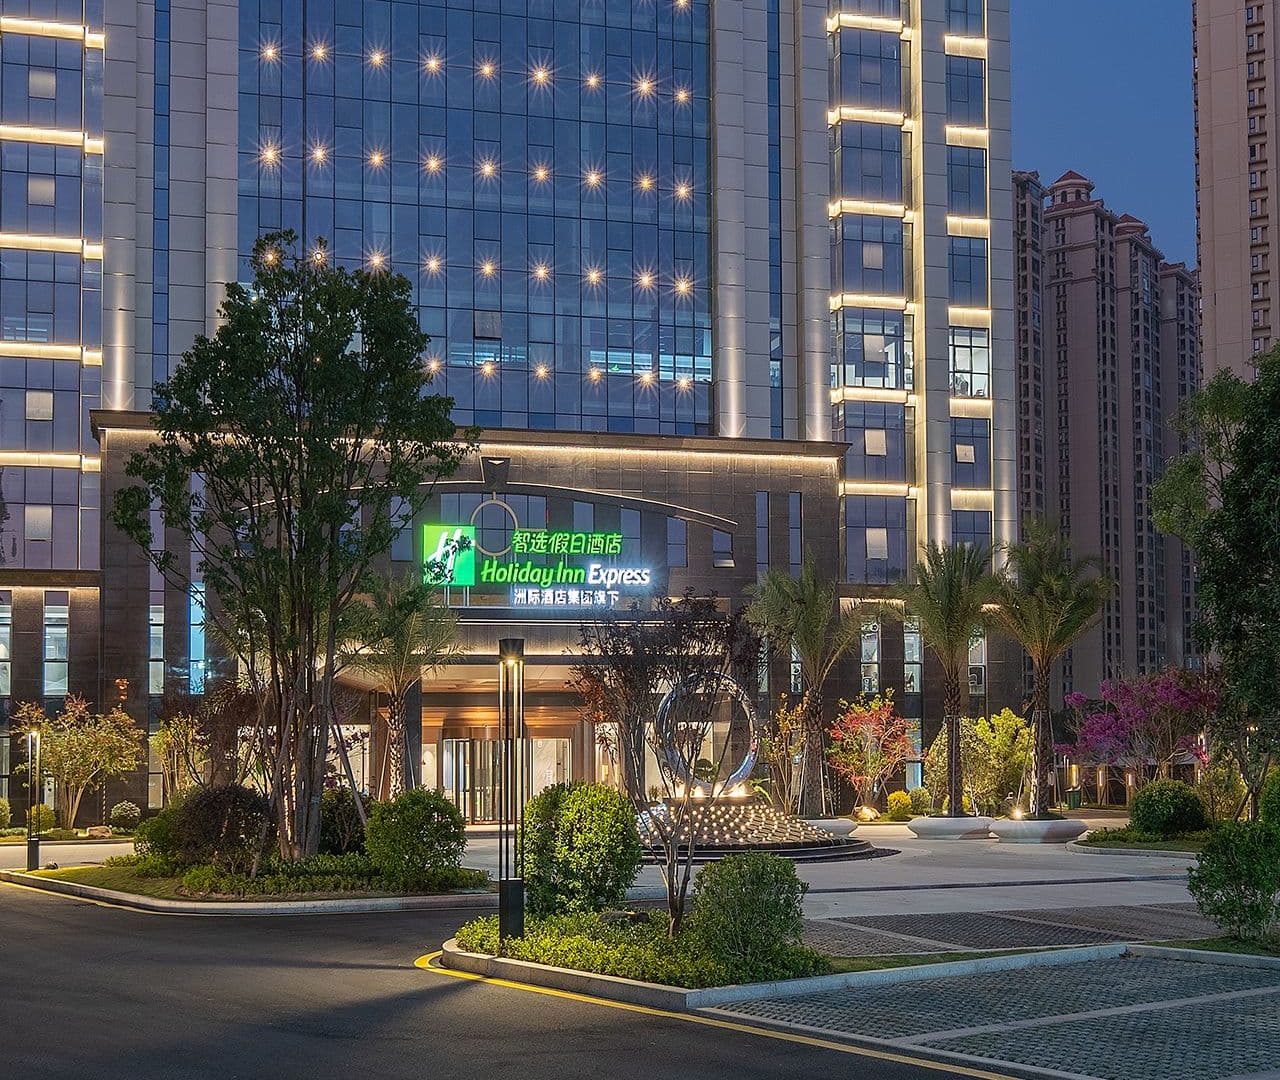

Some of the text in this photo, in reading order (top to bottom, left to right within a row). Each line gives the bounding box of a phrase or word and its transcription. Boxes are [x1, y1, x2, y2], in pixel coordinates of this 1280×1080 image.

[512, 531, 623, 554] 智选假日酒店
[481, 559, 650, 588] Holiday Inn Express
[514, 589, 619, 605] 洲际酒店集团旗下
